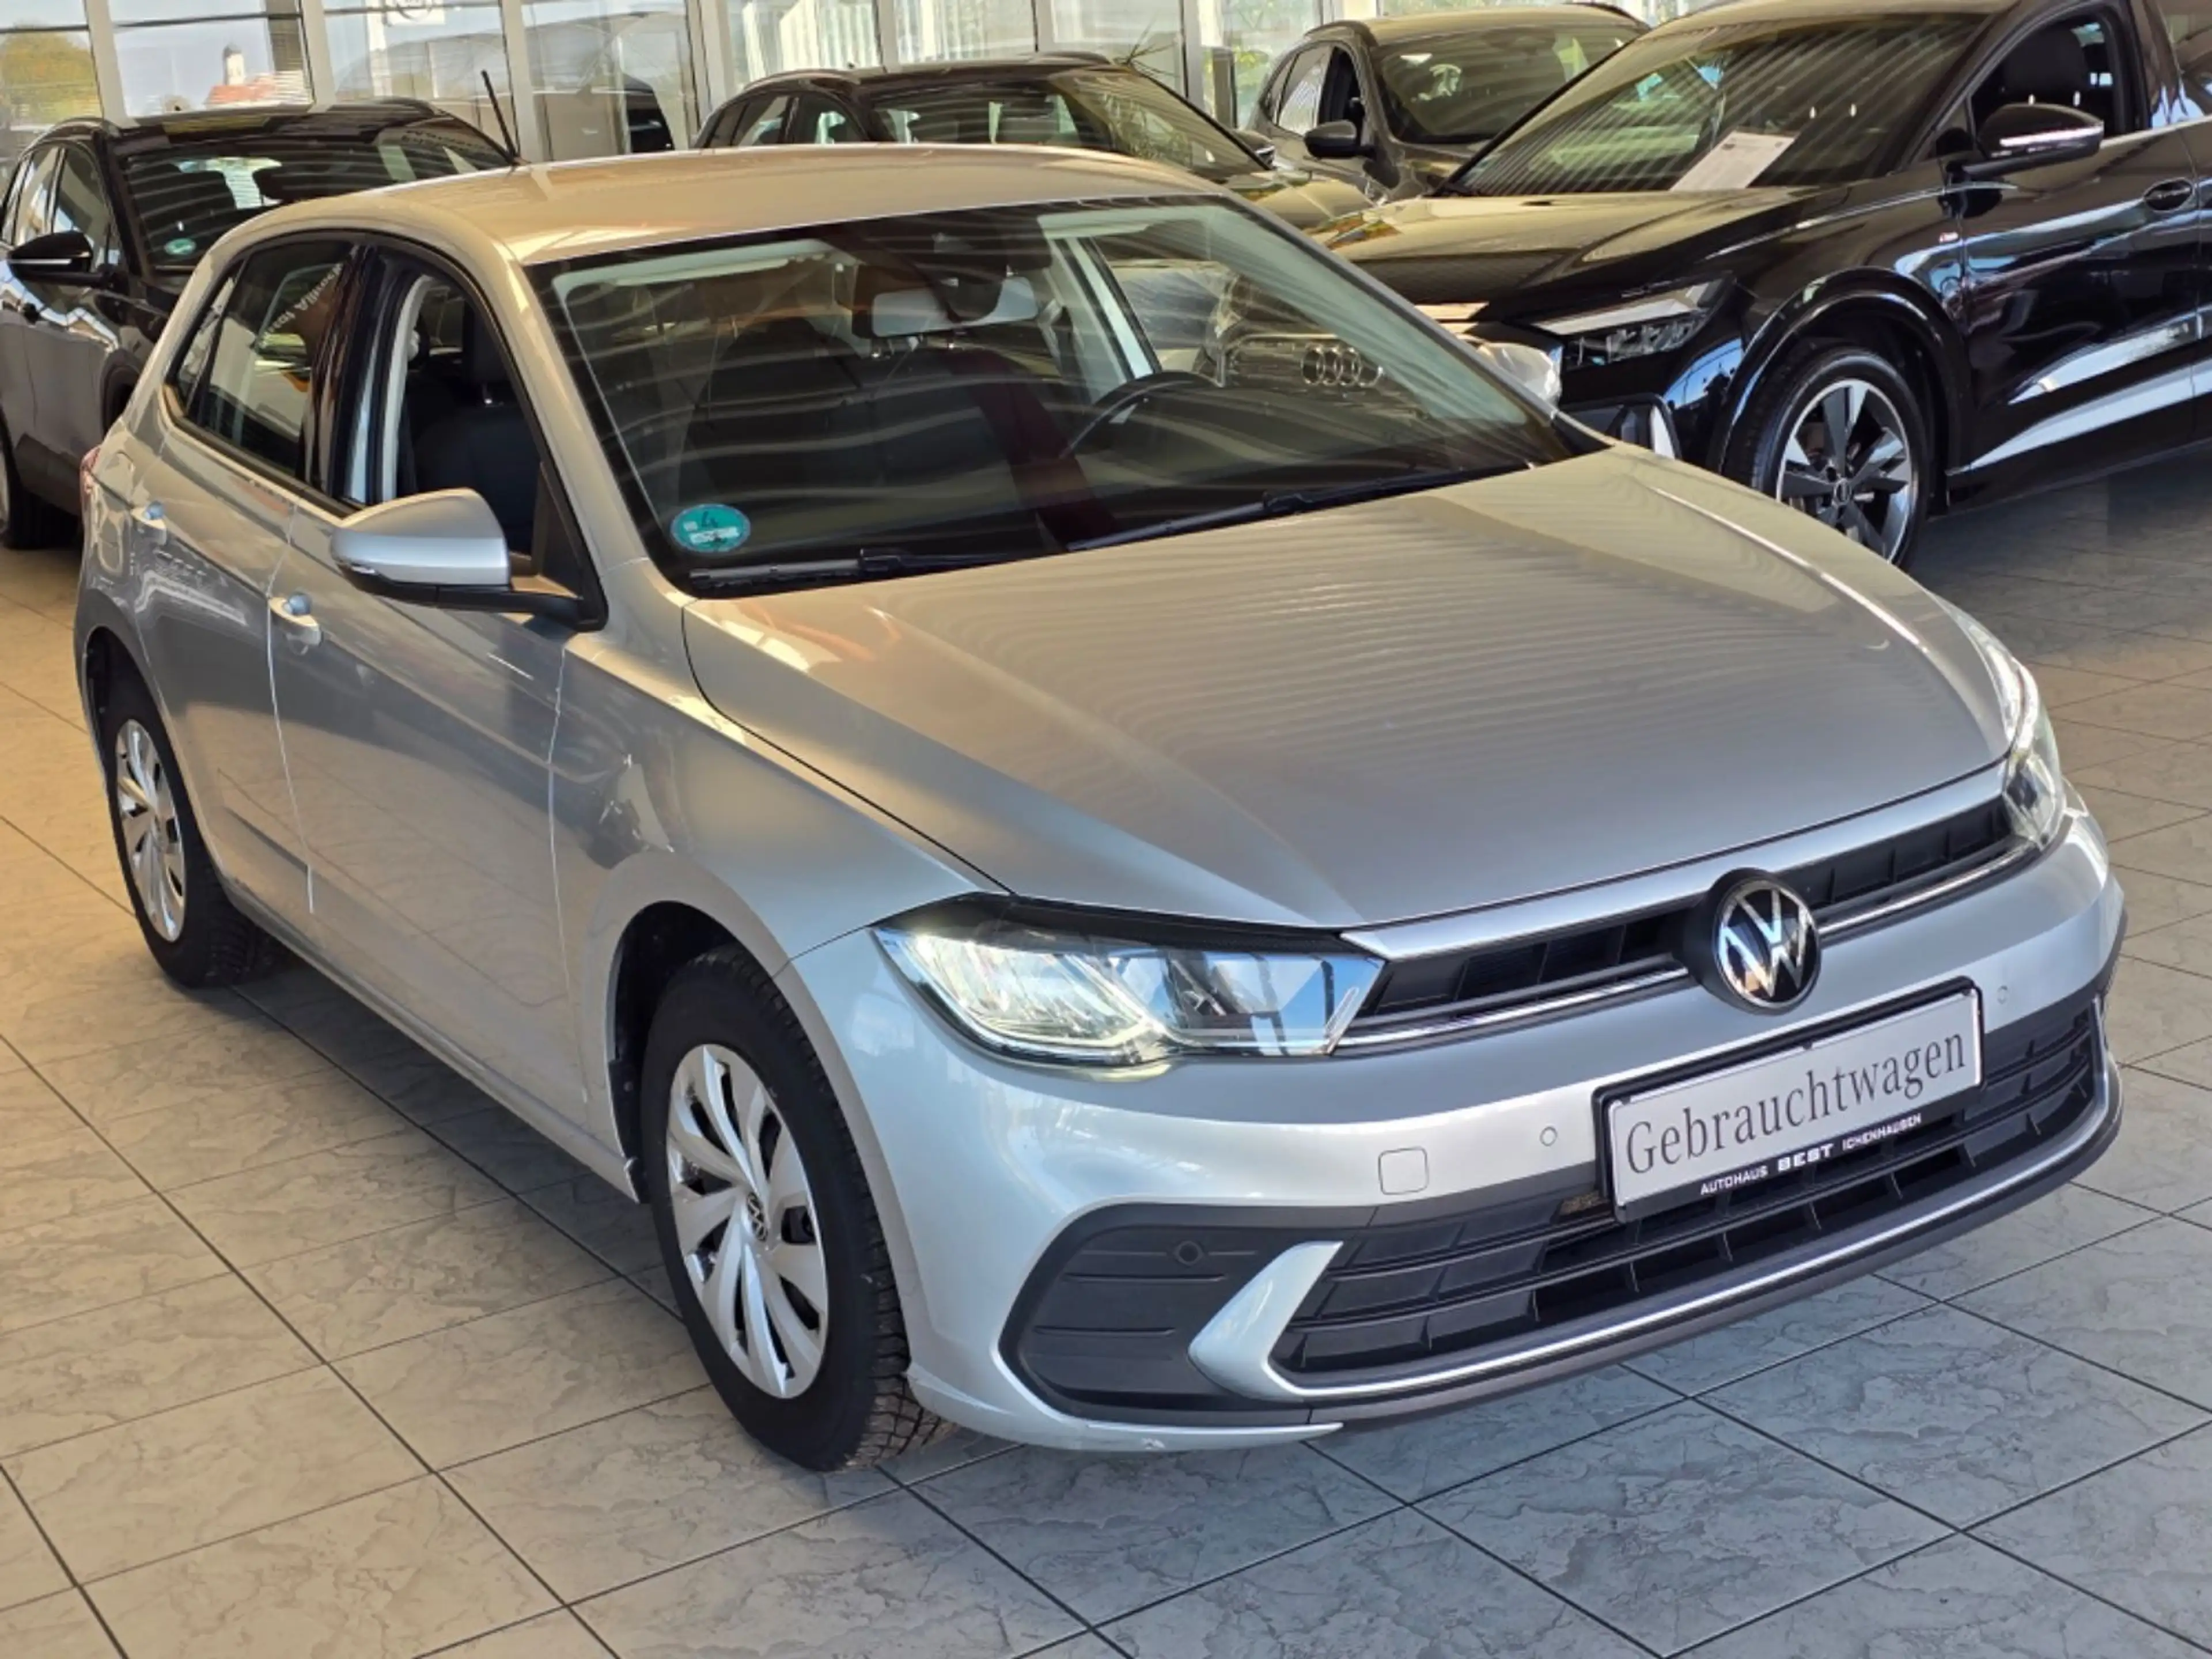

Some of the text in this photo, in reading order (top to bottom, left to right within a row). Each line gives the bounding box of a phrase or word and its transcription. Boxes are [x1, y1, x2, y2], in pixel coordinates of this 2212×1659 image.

[1626, 1032, 1966, 1175] Gebrauchtwagen
[1700, 1165, 1768, 1195] AUTOHAUS
[1777, 1143, 1835, 1172] BEST
